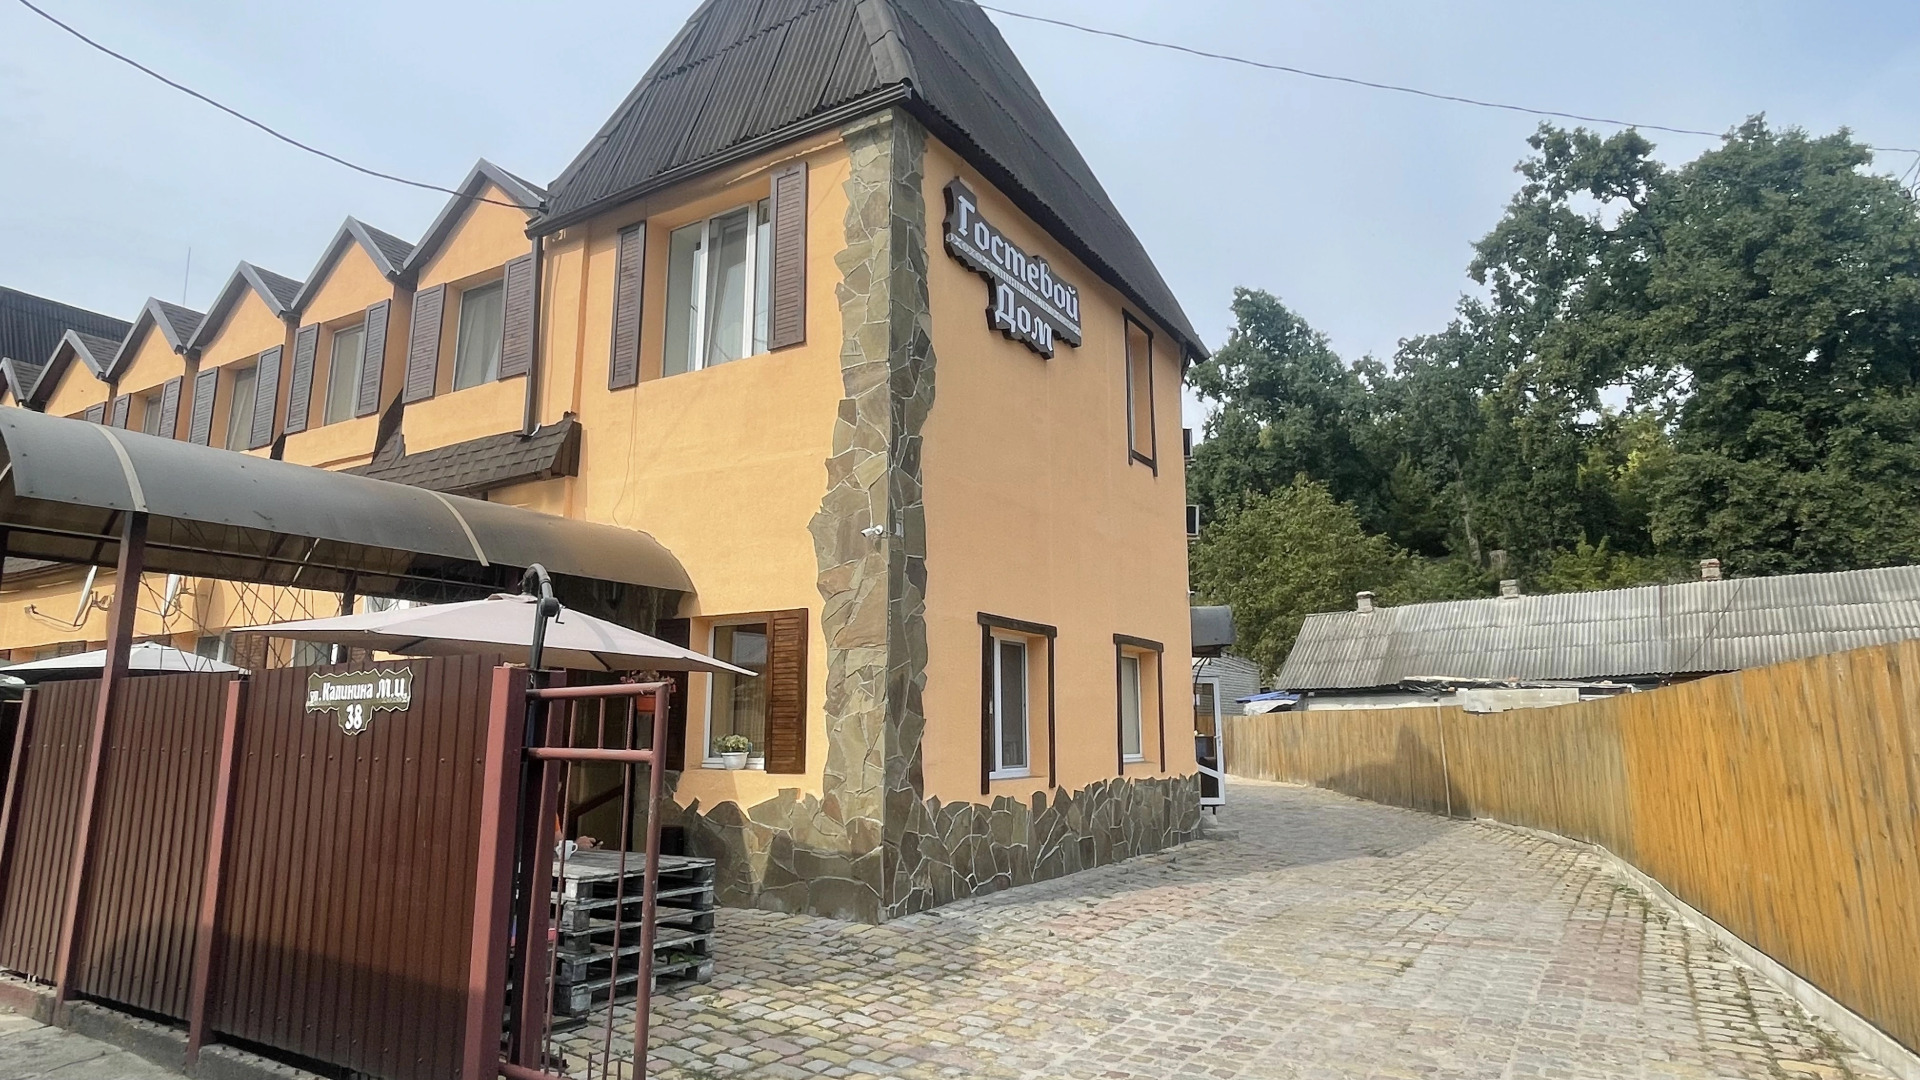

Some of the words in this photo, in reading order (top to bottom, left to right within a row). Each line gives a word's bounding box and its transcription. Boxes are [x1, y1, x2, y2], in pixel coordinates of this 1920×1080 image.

[958, 195, 1079, 322] Гостевой
[994, 283, 1053, 351] Дом
[310, 690, 321, 702] ул.
[322, 682, 373, 700] Калинина
[345, 704, 363, 729] 38
